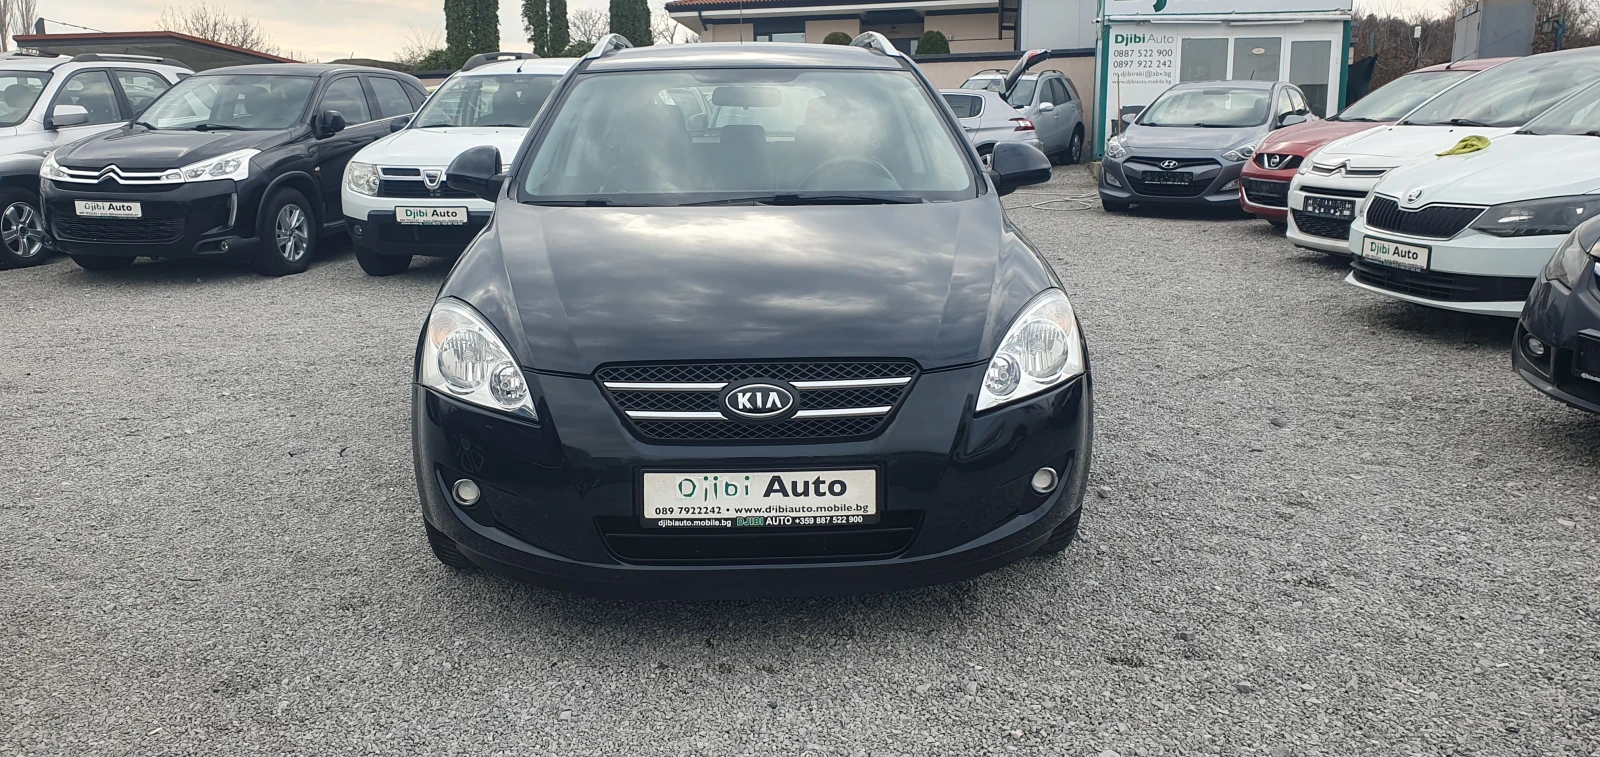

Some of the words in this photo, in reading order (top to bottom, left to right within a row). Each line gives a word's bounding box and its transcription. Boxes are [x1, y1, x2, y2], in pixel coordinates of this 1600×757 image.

[1114, 34, 1146, 47] Djibi
[1147, 34, 1174, 44] Auto
[1113, 49, 1135, 58] 0887
[1137, 49, 1154, 58] 522
[1156, 48, 1173, 57] 900
[1113, 60, 1134, 68] 0897
[1137, 60, 1153, 68] 922
[1156, 60, 1172, 68] 242
[84, 202, 105, 212] Djibi
[107, 203, 132, 212] Auto
[405, 209, 428, 219] Djibi
[431, 209, 458, 218] Auto
[1370, 241, 1391, 256] Djibi
[1392, 245, 1419, 260] Auto
[736, 391, 783, 410] KIA
[677, 475, 751, 502] Djibi
[762, 475, 848, 498] Auto
[654, 507, 674, 515] 089
[677, 506, 722, 515] 7922242
[658, 519, 732, 528] djibiauto.mobile.bg
[736, 516, 765, 526] DJIBI
[765, 516, 793, 525] AUTO
[794, 517, 814, 525] +359
[816, 516, 831, 524] 887
[832, 516, 847, 524] 522
[848, 515, 863, 523] 900
